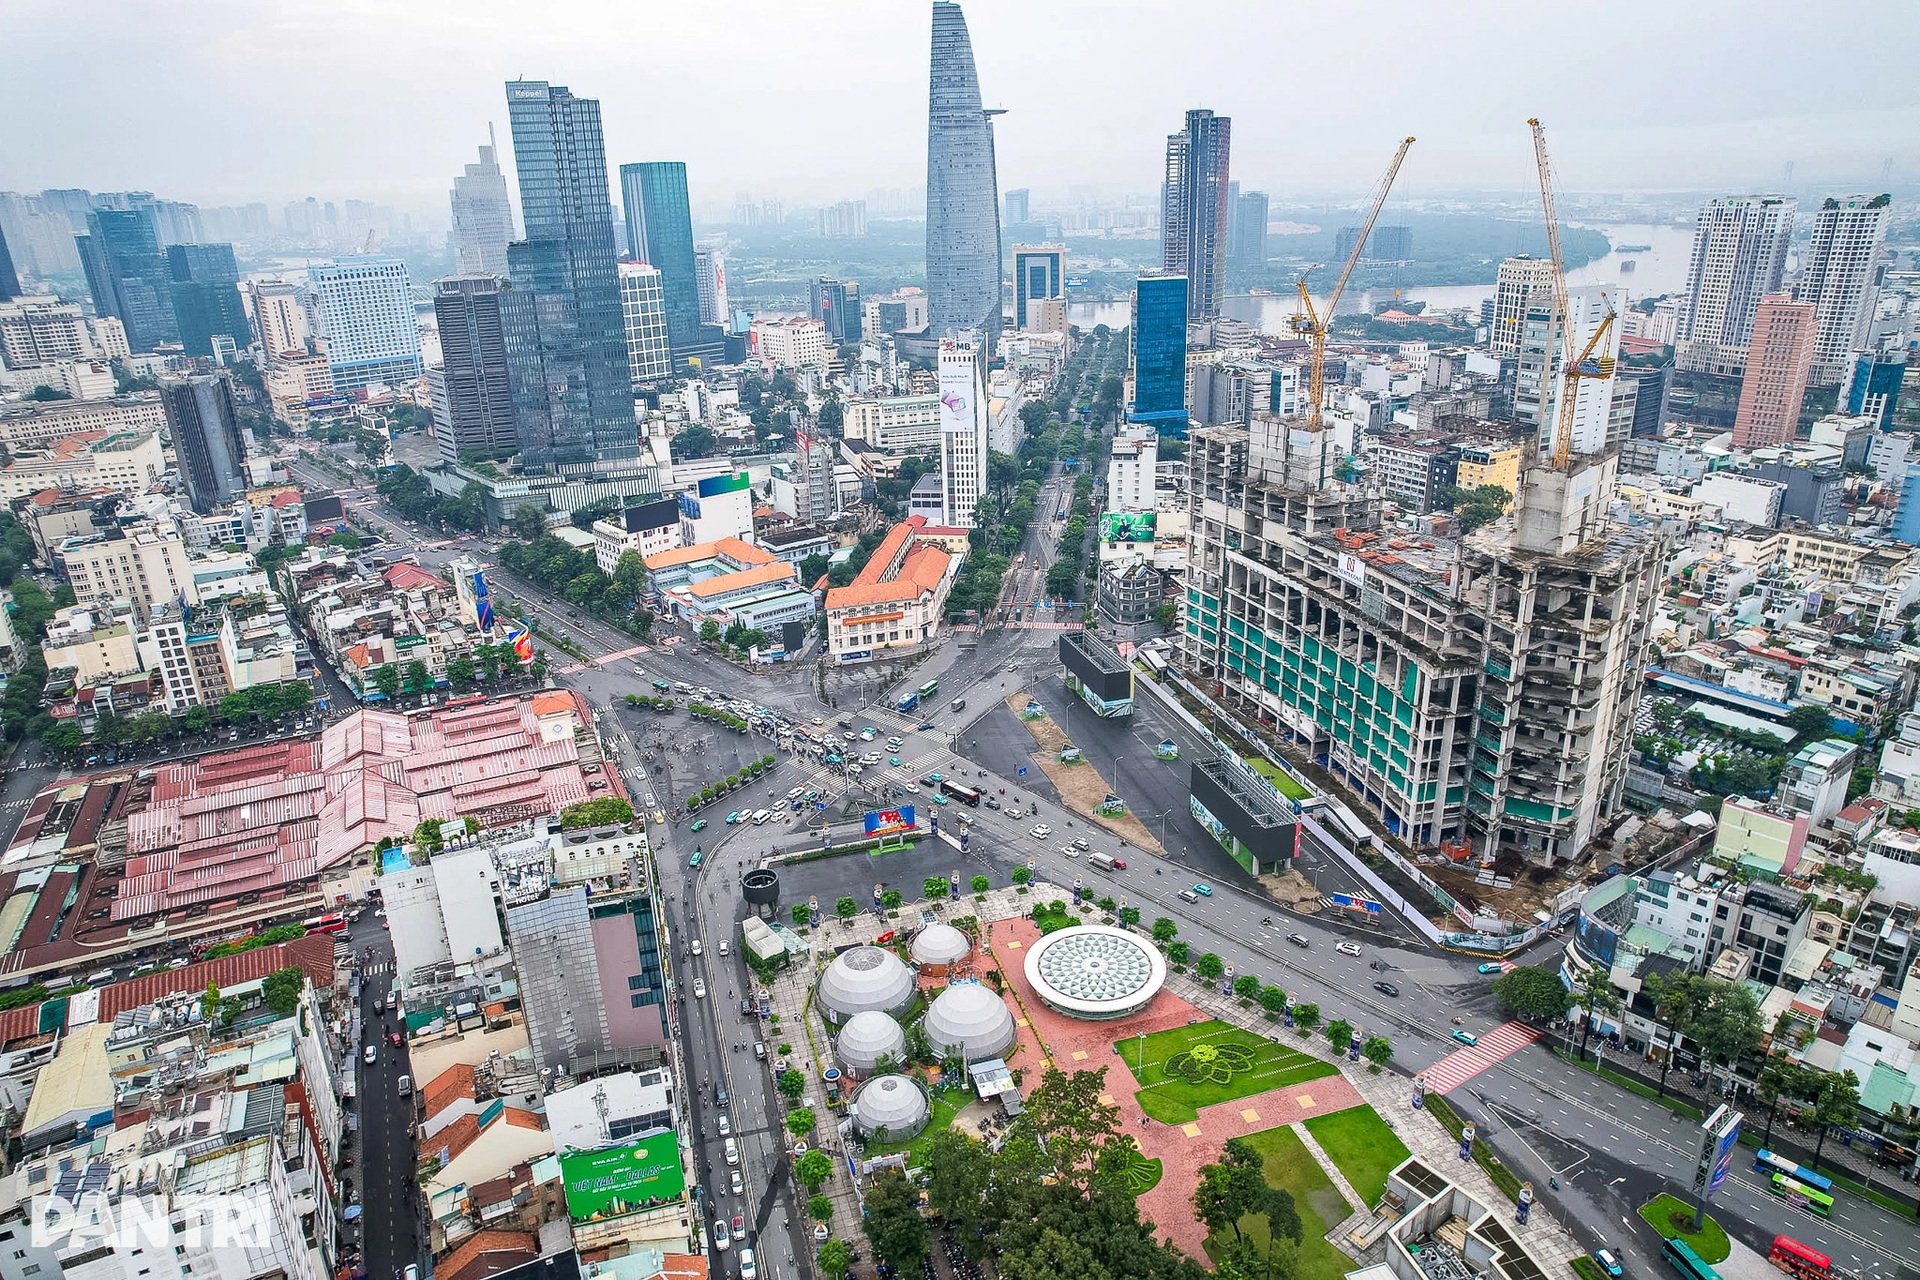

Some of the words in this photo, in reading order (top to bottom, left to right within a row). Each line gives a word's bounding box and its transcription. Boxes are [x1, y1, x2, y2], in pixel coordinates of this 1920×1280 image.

[515, 90, 542, 98] Keppel
[956, 342, 971, 350] MB
[627, 1164, 661, 1181] DALLAS
